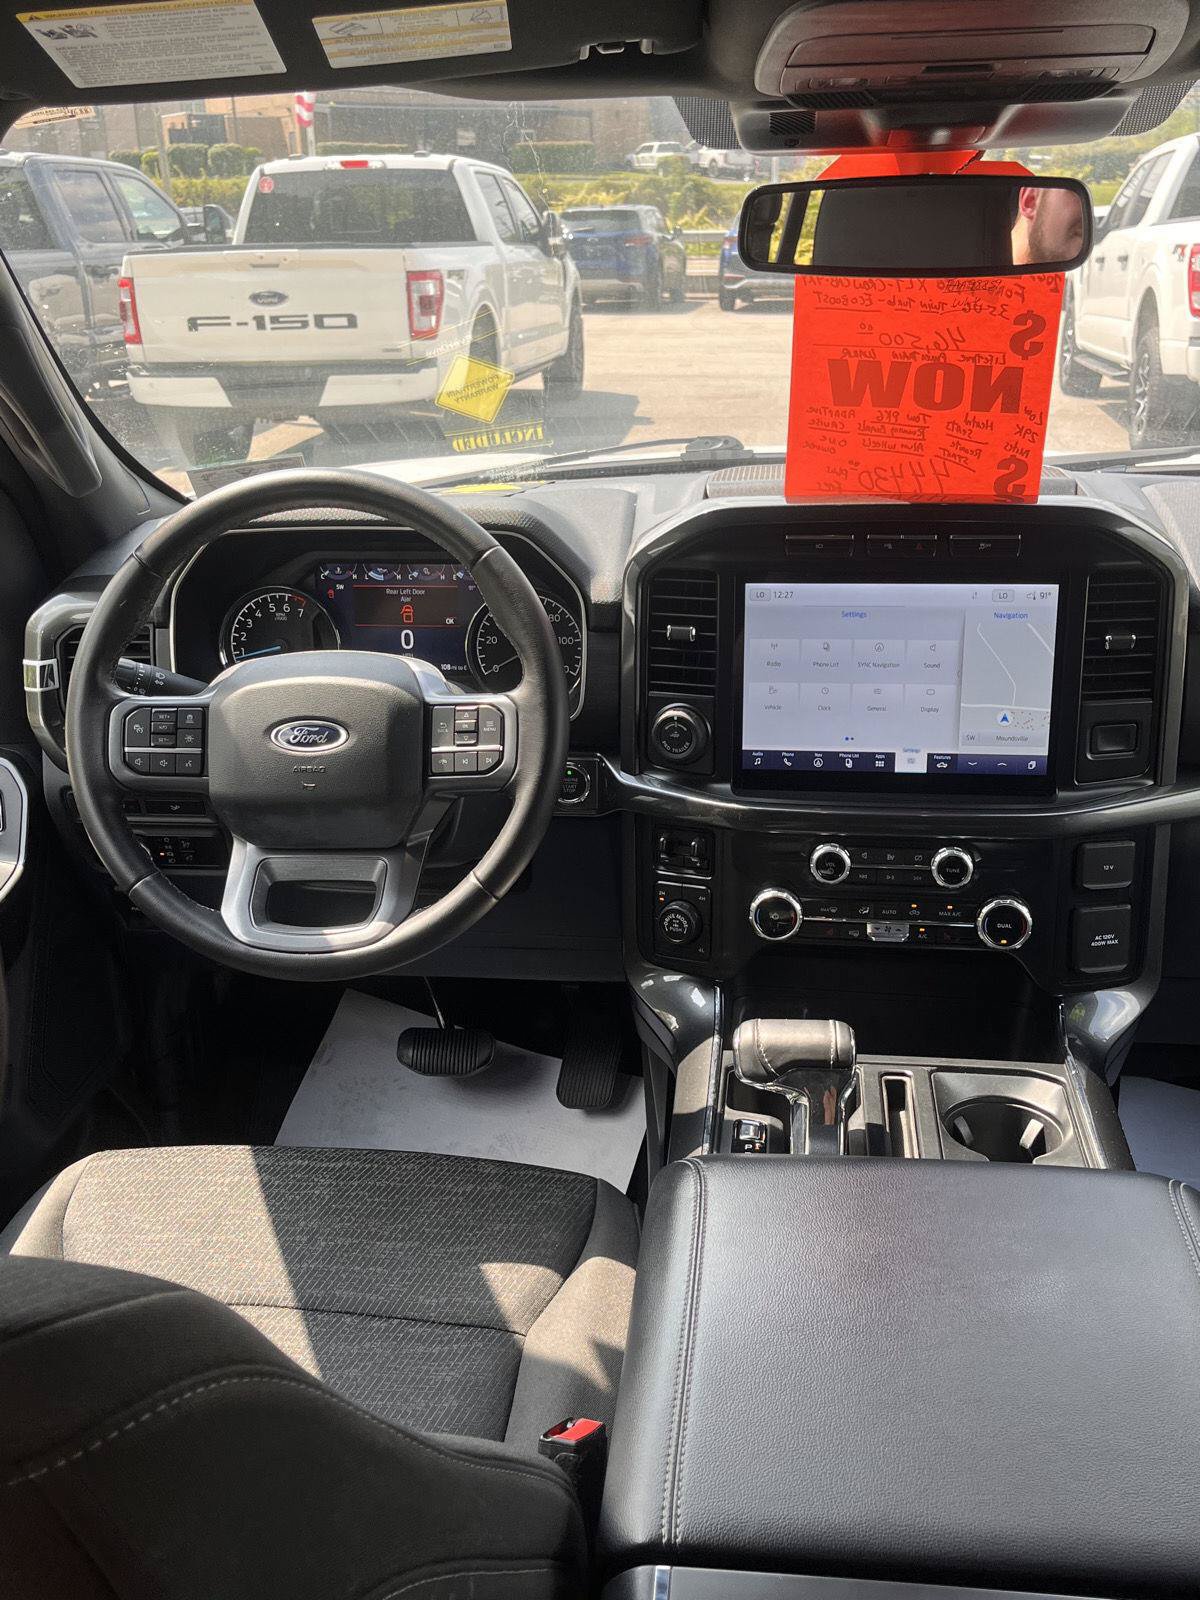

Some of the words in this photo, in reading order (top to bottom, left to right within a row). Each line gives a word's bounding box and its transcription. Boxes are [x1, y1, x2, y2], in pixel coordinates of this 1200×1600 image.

[187, 313, 358, 332] F-150
[773, 591, 794, 599] 12:27
[255, 609, 262, 618] 4
[269, 603, 277, 612] 5
[283, 603, 291, 613] 6
[297, 608, 304, 618] 7
[841, 610, 868, 620] Settings
[993, 611, 1029, 620] Navigation
[246, 619, 253, 628] 3
[445, 617, 455, 625] OK
[240, 632, 247, 641] 2
[400, 629, 415, 650] 0
[486, 636, 498, 644] 20
[872, 661, 900, 669] Navigation
[920, 706, 940, 714] Display
[289, 726, 329, 744] Ford
